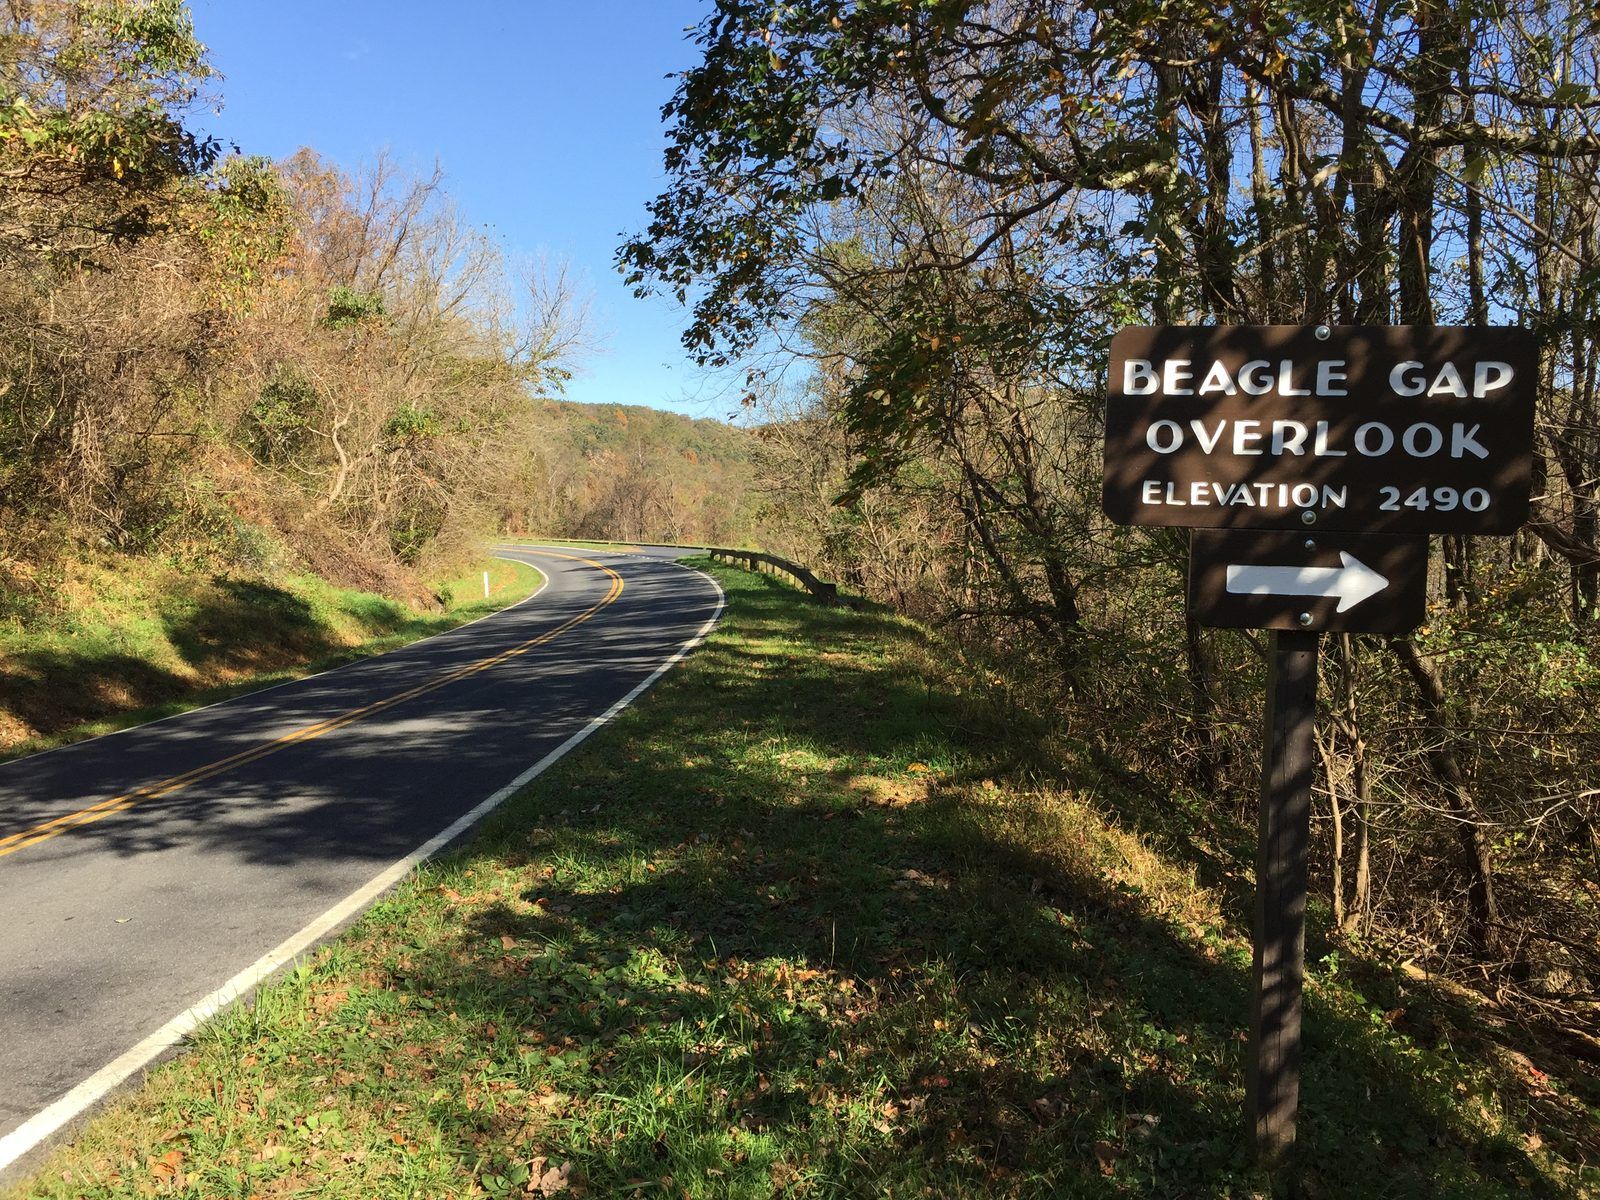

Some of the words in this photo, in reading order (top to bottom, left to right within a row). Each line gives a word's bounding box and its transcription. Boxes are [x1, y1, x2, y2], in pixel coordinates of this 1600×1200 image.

[1123, 359, 1349, 397] BEAGLE
[1389, 360, 1515, 399] GAP
[1145, 419, 1490, 460] OVERLOOK
[1141, 480, 1348, 510] ELEVATION
[1379, 486, 1492, 513] 2490
